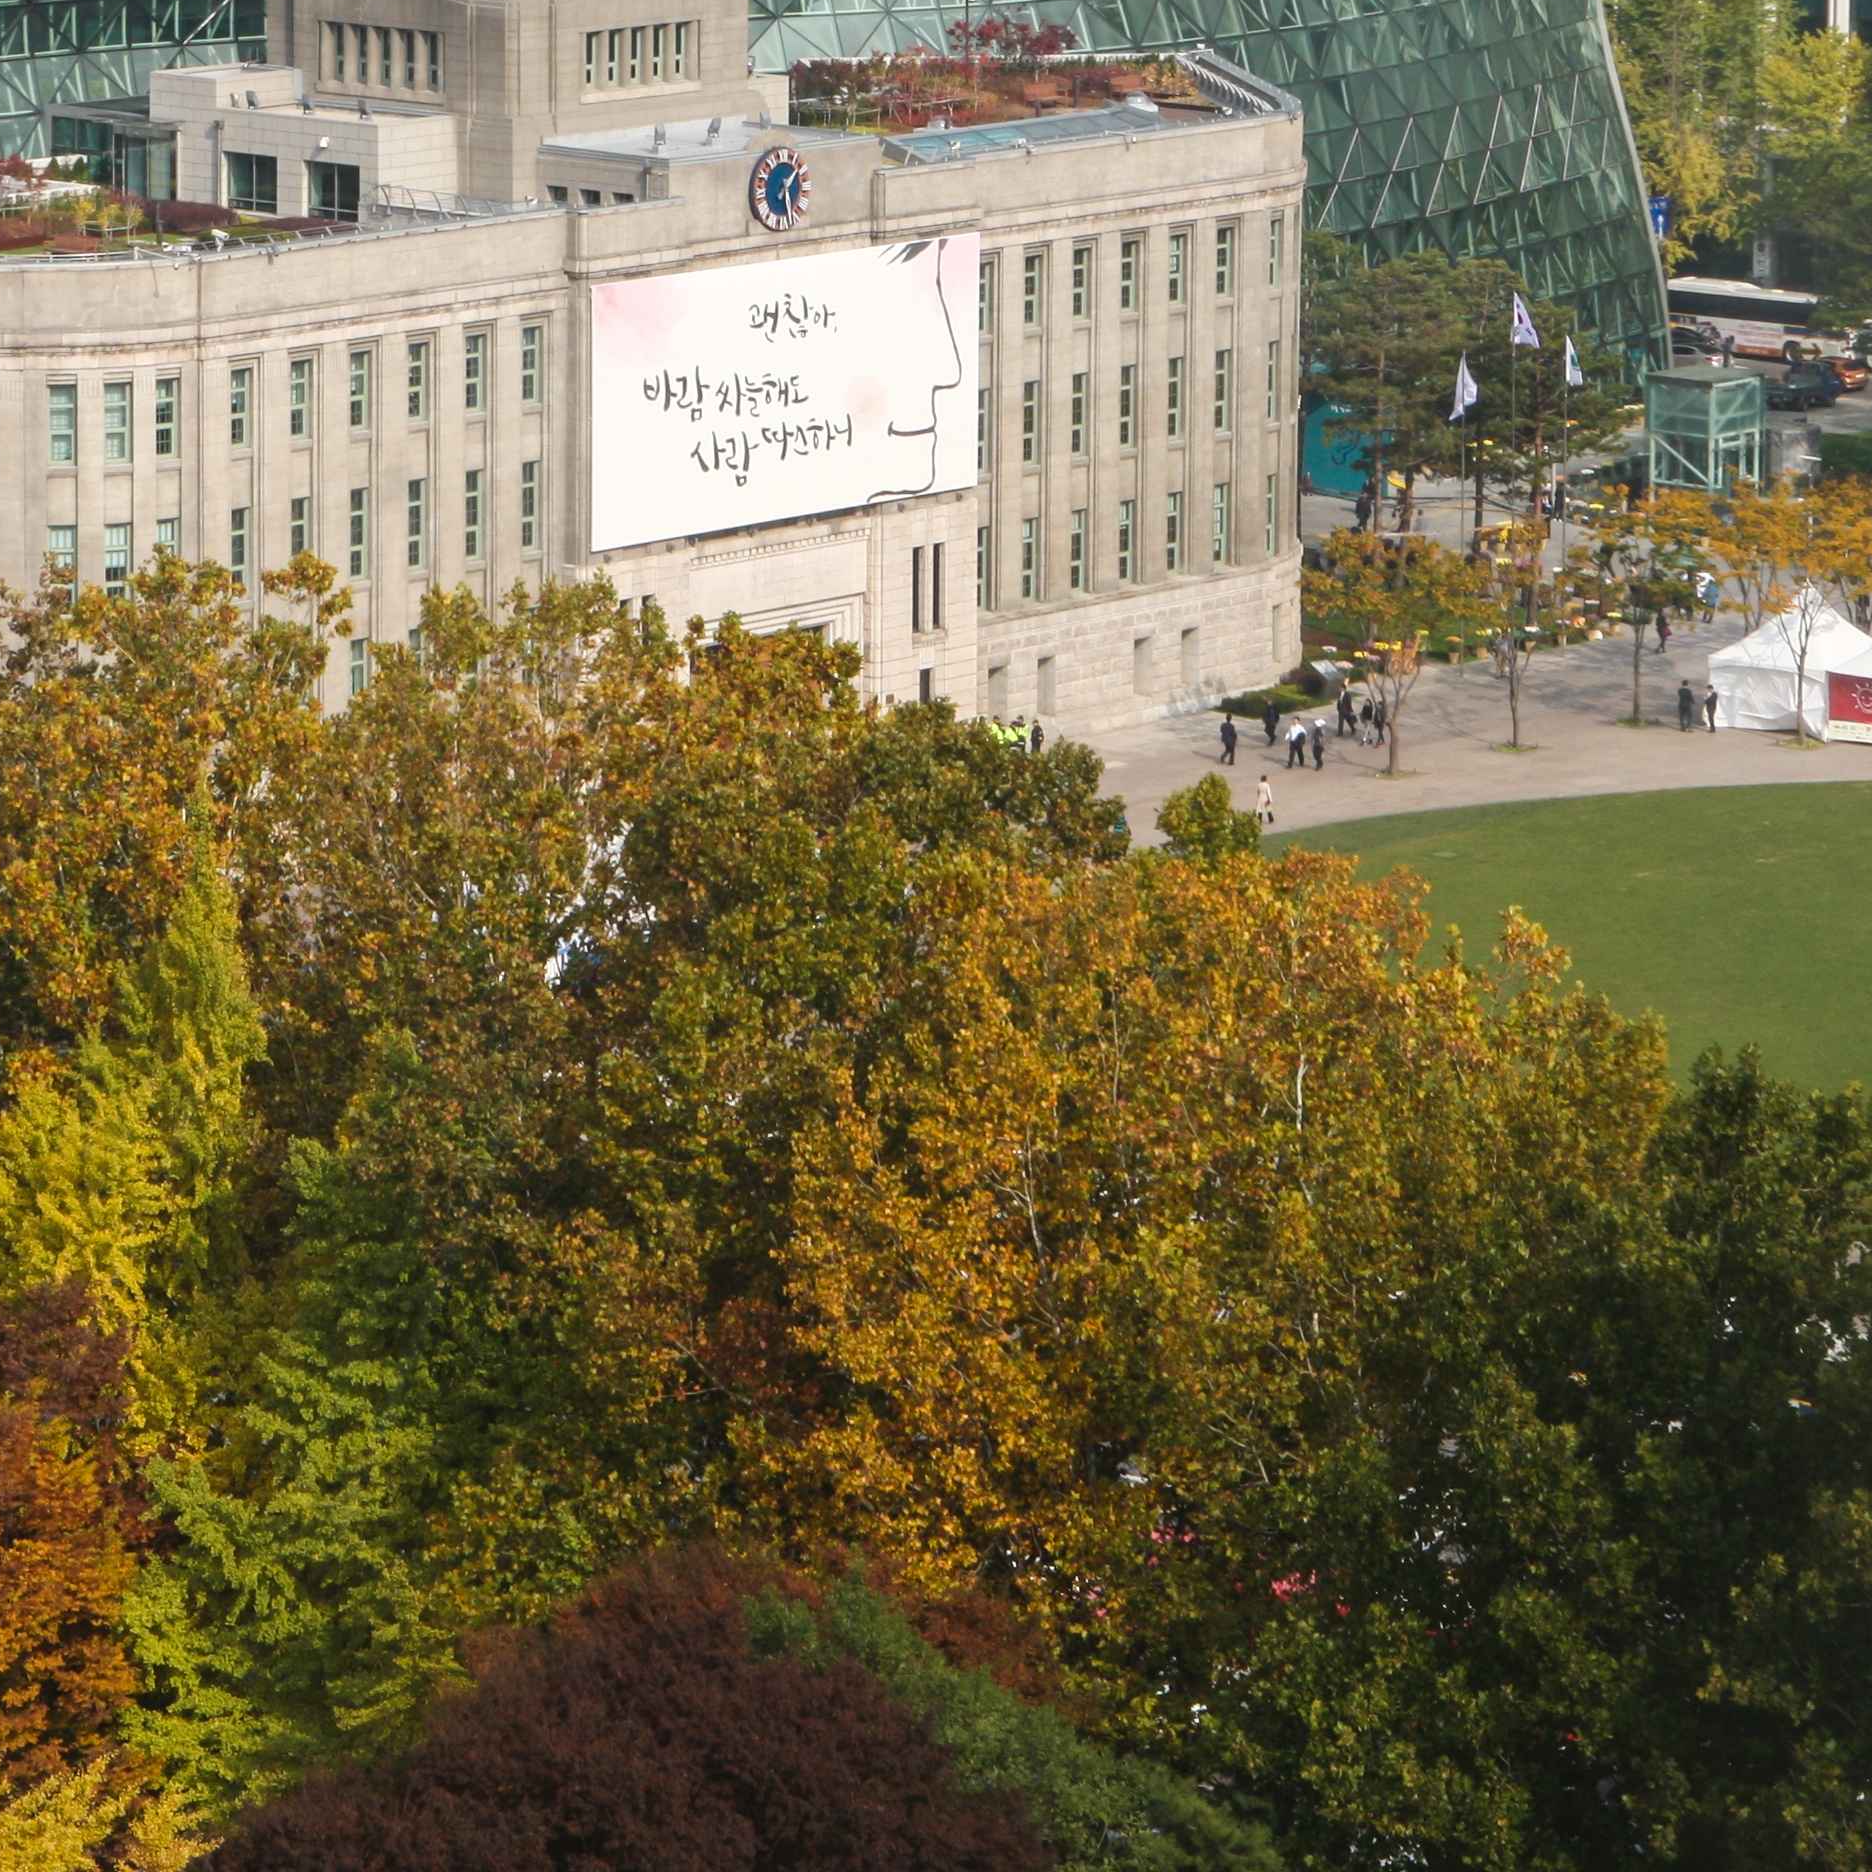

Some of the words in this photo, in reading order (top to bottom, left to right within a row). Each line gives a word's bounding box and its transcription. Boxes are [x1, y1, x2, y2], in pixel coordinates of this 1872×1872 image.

[643, 365, 710, 422] 바람
[715, 373, 809, 417] 싸늘해도
[690, 431, 760, 487] 사람
[761, 413, 853, 460] 따스하니
